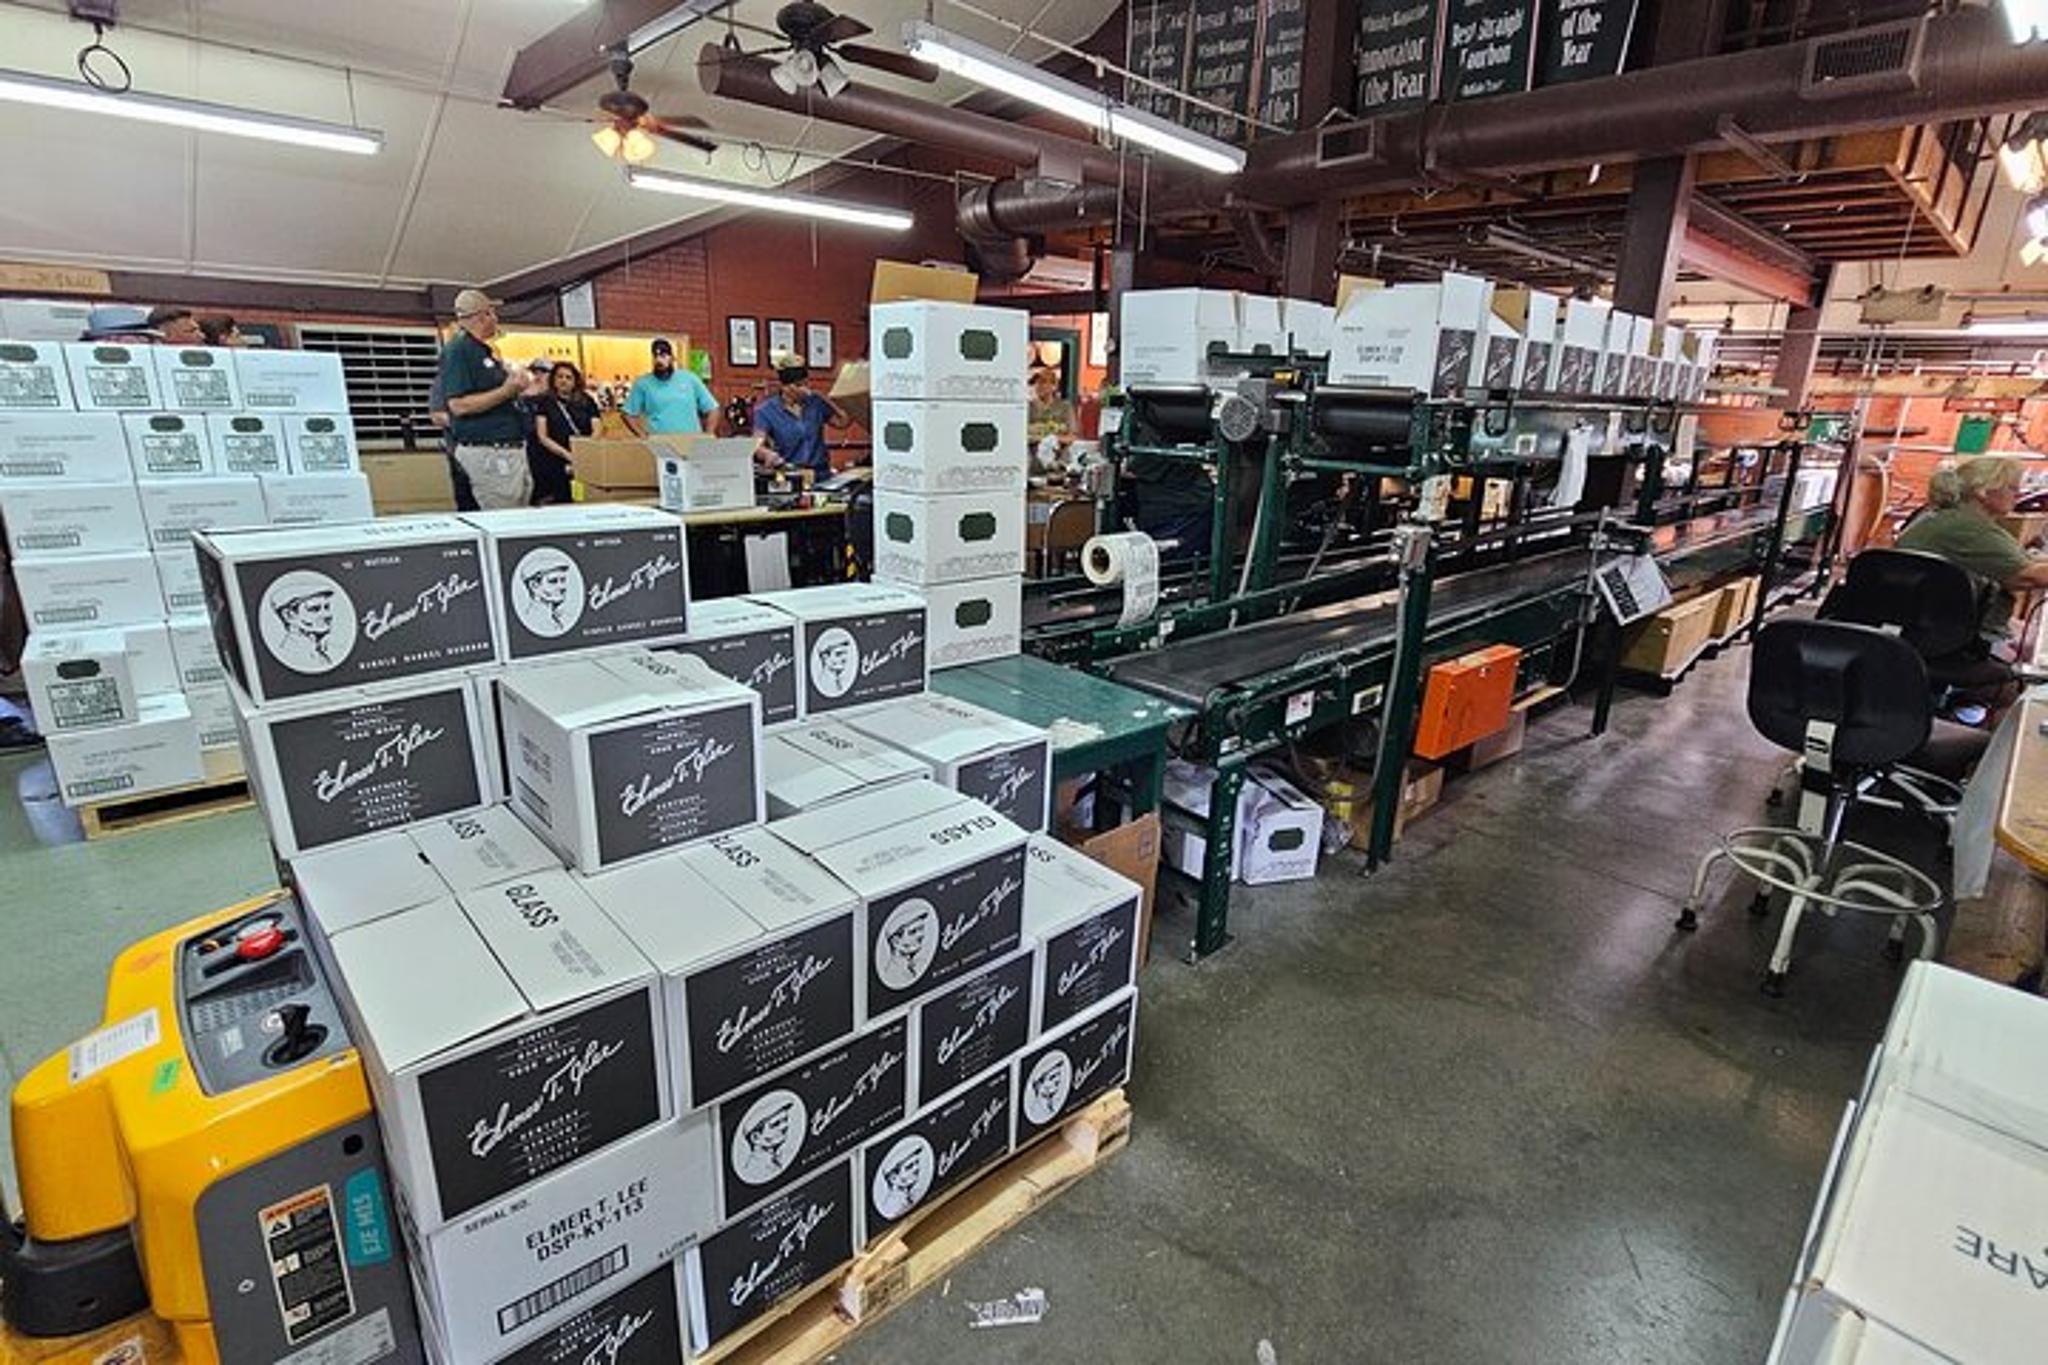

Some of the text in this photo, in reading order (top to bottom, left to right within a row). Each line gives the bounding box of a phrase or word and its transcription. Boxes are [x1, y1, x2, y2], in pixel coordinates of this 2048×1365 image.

[1577, 8, 1602, 35] the
[1561, 39, 1594, 67] Year
[1391, 70, 1427, 100] Year
[360, 602, 419, 641] Elmer
[312, 760, 376, 803] Elmer
[619, 774, 675, 817] Elmer
[505, 884, 559, 928] GLASS
[467, 1102, 544, 1158] Elmer
[570, 1039, 624, 1096] Lee
[525, 1177, 649, 1250] ELMER T. LEE
[536, 1197, 645, 1262] DSP-KY-113
